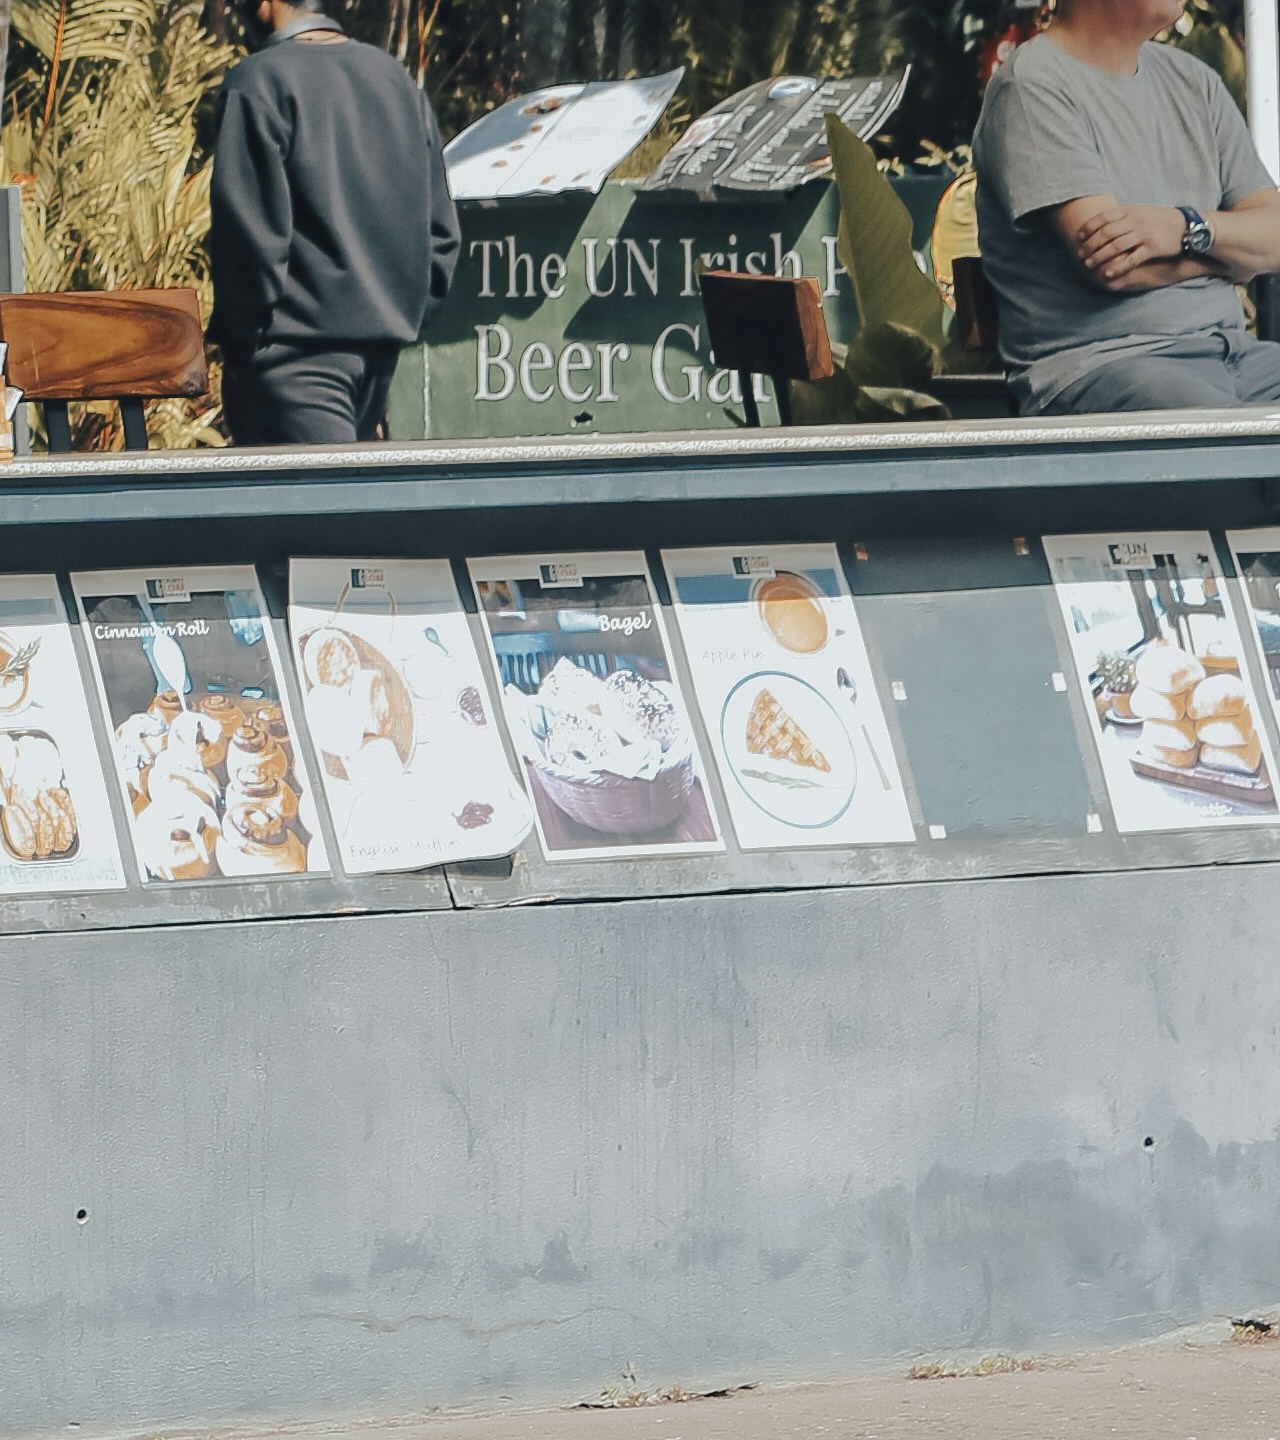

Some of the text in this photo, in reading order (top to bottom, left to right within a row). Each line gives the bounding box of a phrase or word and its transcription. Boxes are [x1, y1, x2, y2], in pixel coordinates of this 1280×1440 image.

[469, 234, 567, 299] The
[581, 236, 659, 297] UN
[474, 323, 630, 403] Beer
[175, 619, 210, 637] Roll
[597, 611, 652, 636] Bagel
[703, 648, 765, 664] Apple Pie
